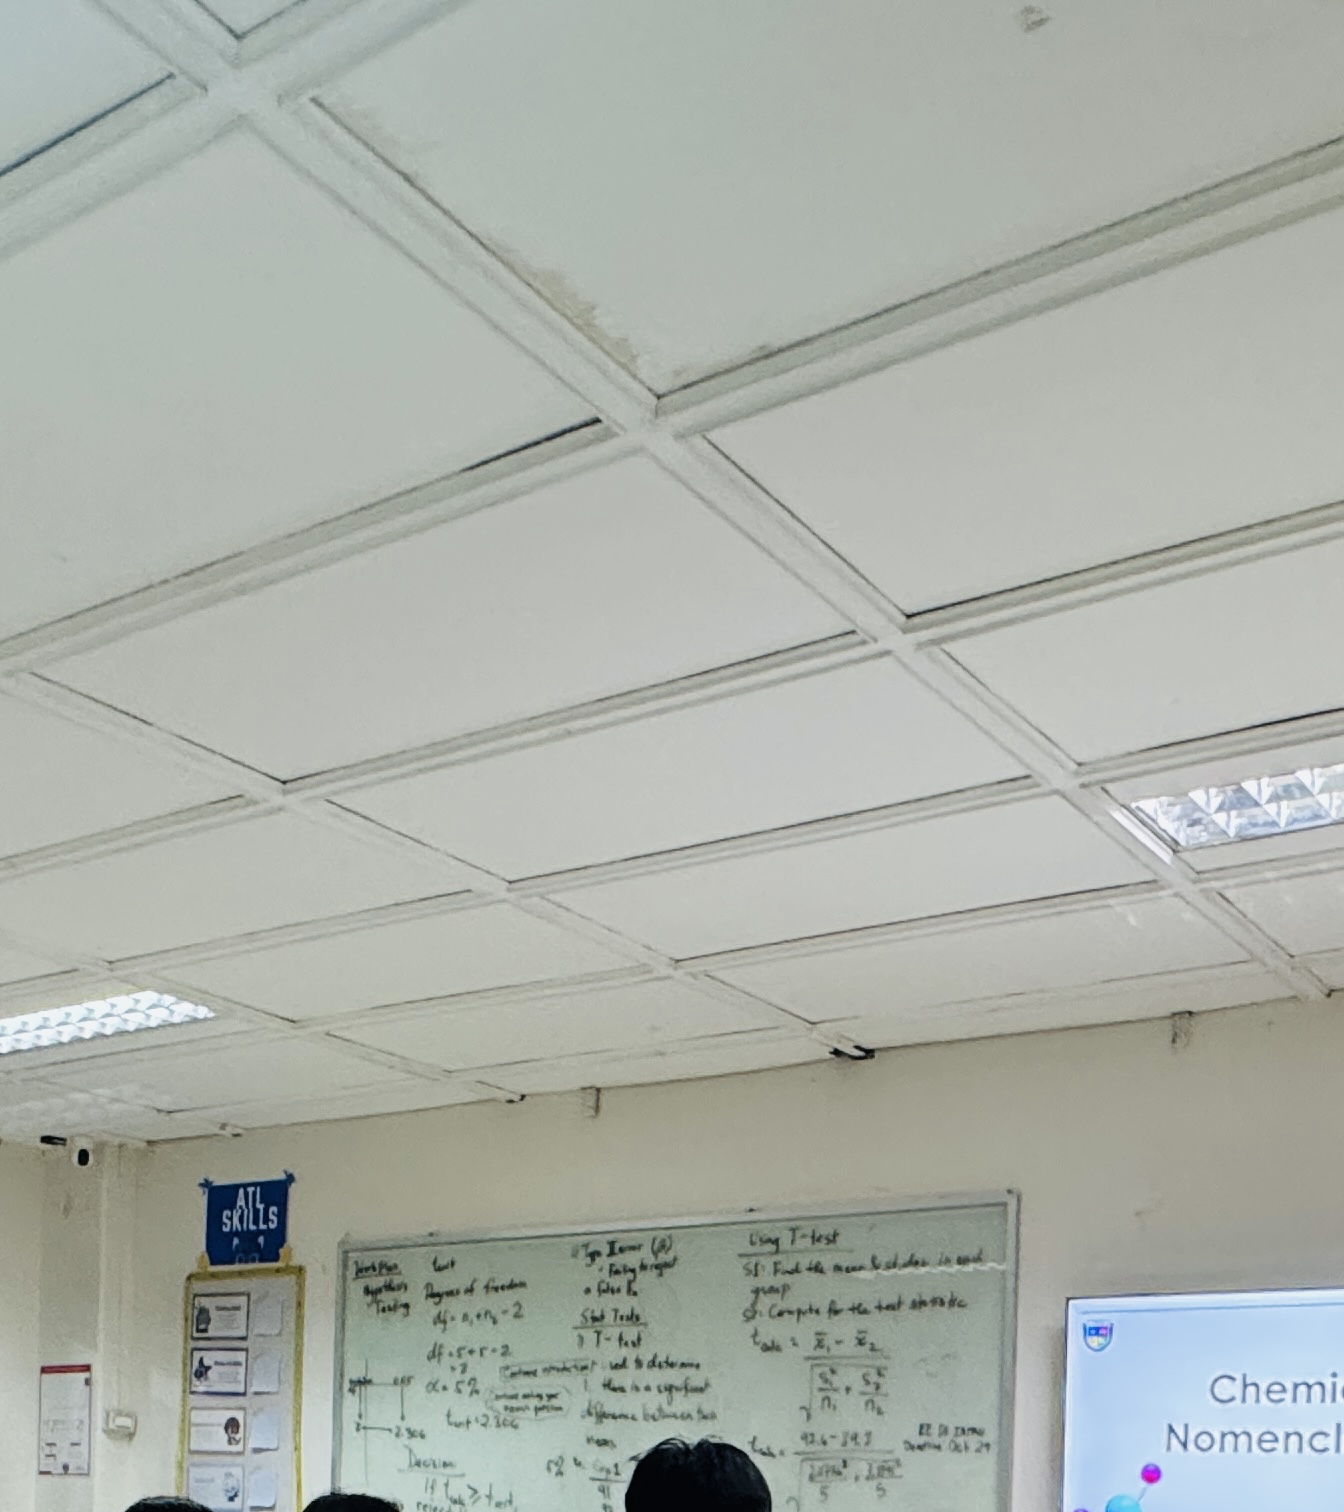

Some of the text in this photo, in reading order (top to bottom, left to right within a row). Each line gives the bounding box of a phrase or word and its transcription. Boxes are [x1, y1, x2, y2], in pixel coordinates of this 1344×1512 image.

[237, 1186, 264, 1209] ATL
[222, 1206, 278, 1232] SKILLS
[789, 1227, 839, 1245] T-test
